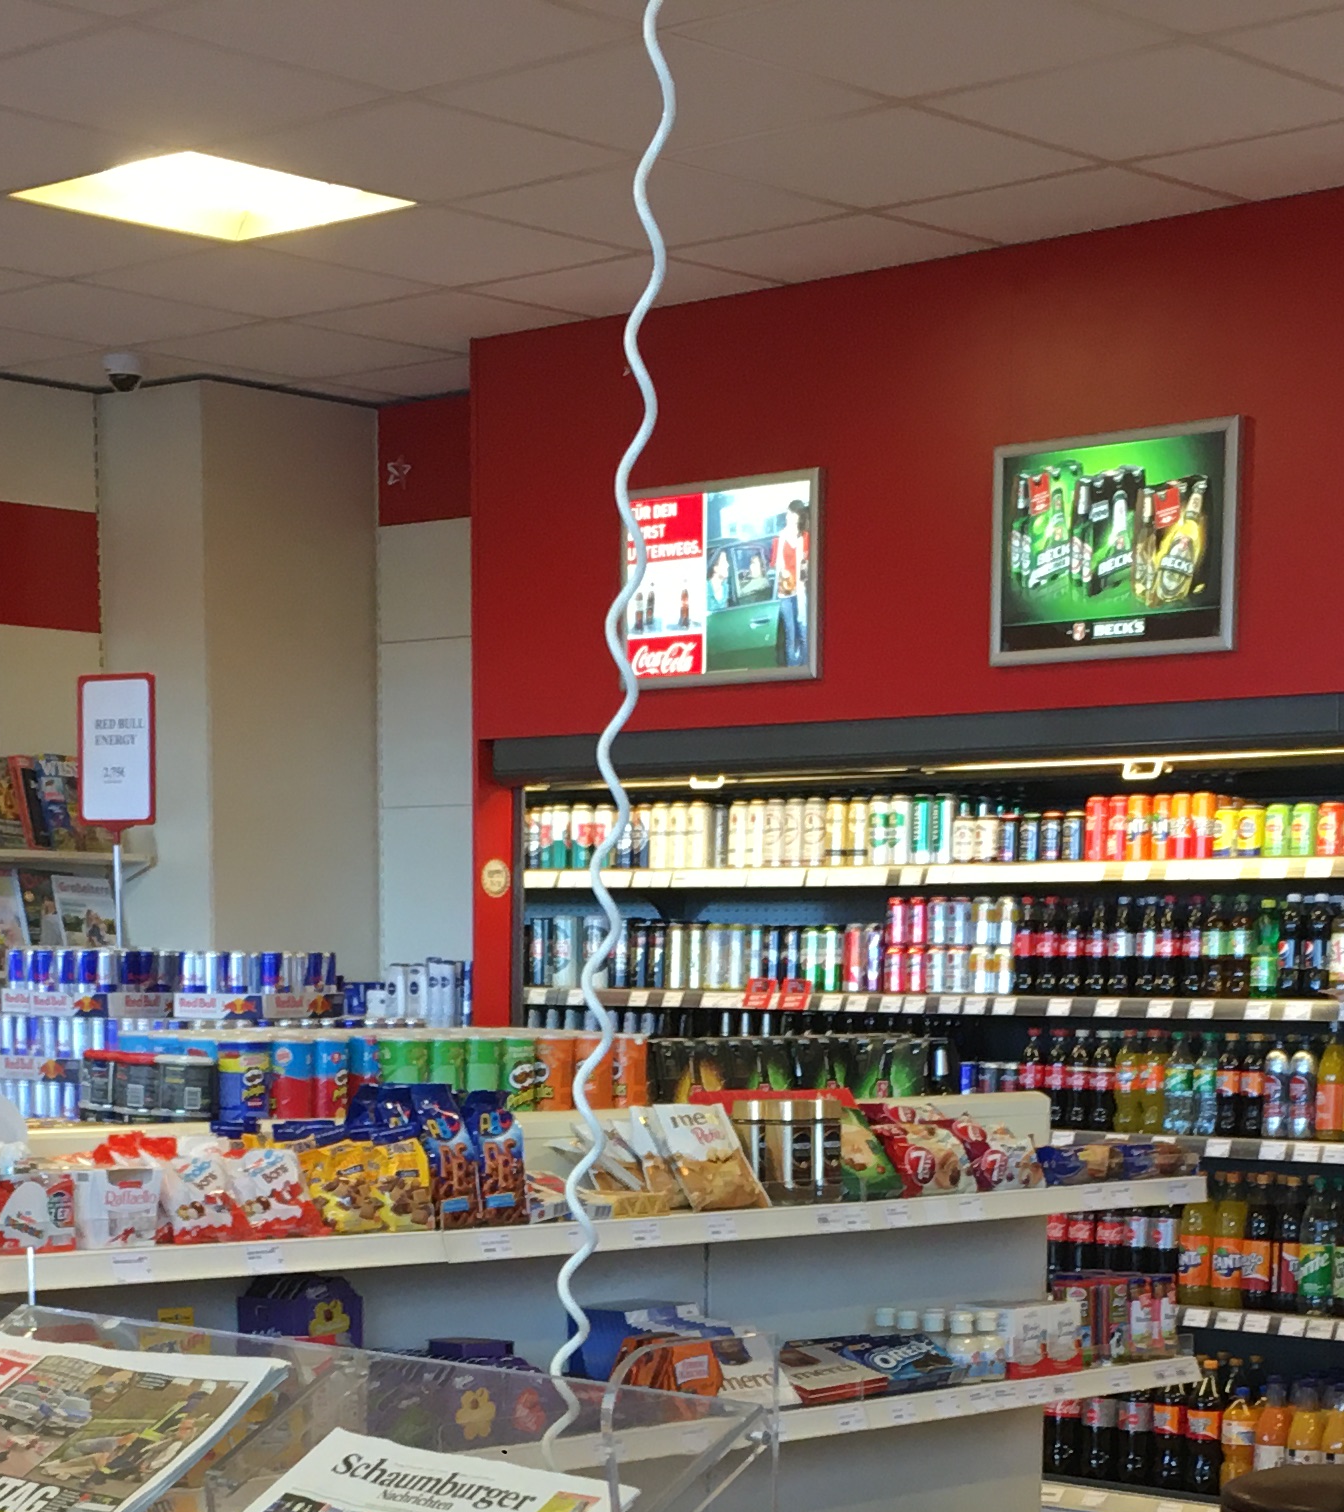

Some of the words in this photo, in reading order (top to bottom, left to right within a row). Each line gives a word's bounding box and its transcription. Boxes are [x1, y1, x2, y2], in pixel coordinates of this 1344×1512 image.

[653, 502, 678, 520] DEN
[627, 540, 702, 562] UTERWEGS.
[1092, 619, 1146, 637] BECK'S
[94, 717, 118, 730] RED
[120, 717, 145, 730] BULL
[94, 735, 138, 748] ENERGY
[870, 1337, 936, 1373] OREO
[376, 1488, 455, 1512] Nachrichten
